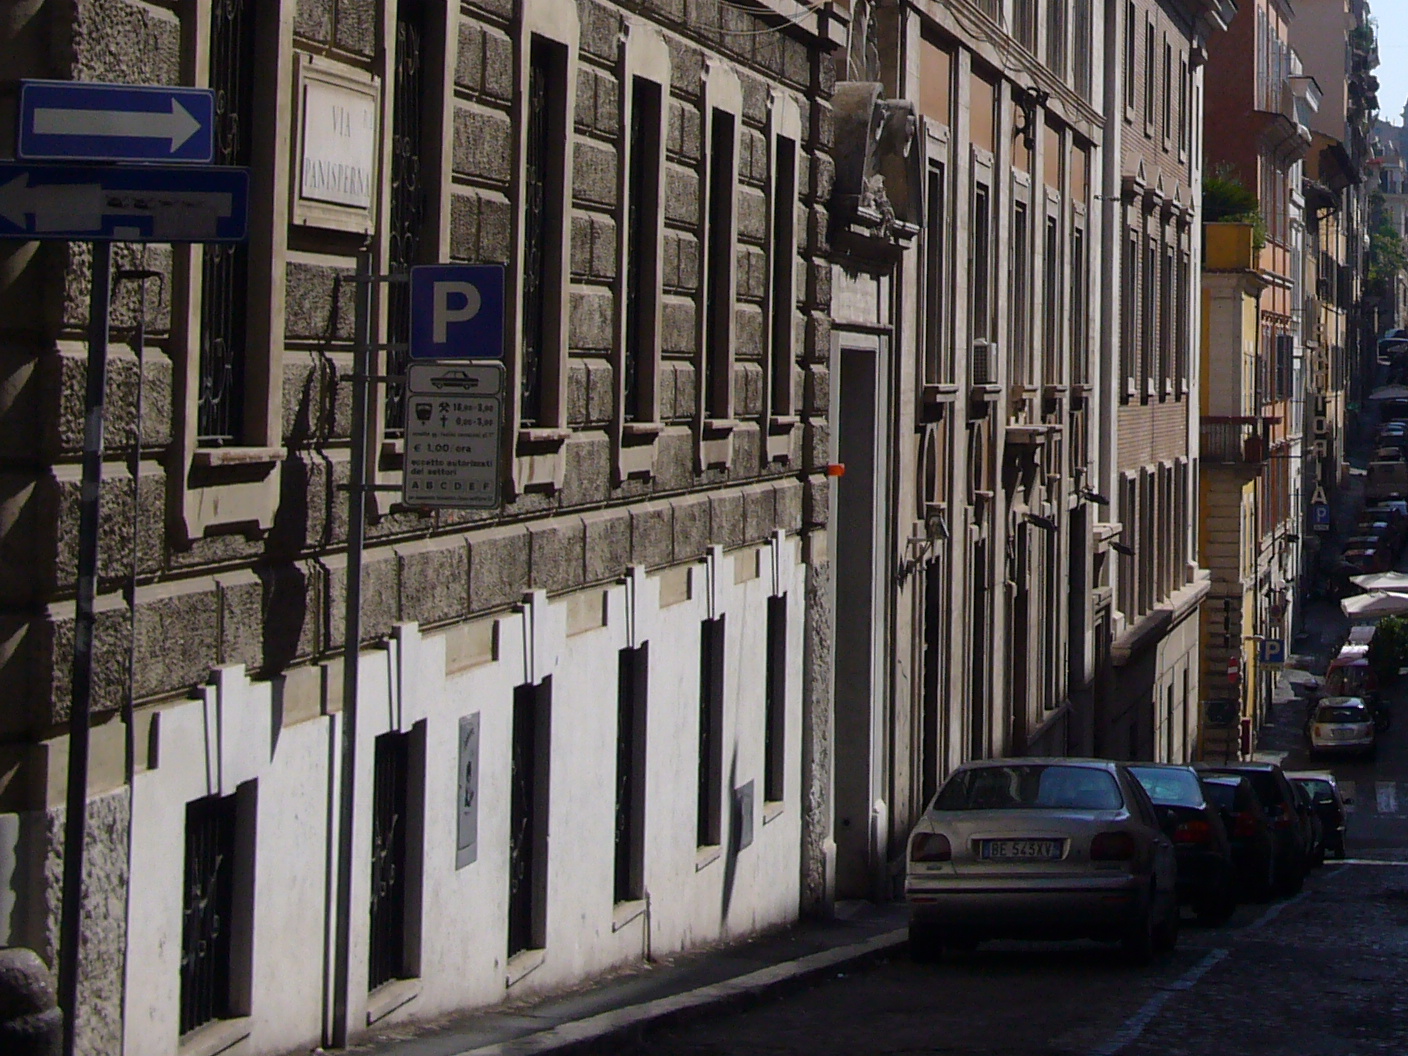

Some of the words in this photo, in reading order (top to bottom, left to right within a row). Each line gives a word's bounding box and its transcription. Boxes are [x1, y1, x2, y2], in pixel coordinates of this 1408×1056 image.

[332, 105, 351, 138] VIA
[305, 157, 370, 198] PANISPERNA
[433, 281, 481, 343] P
[412, 481, 419, 489] A
[426, 481, 433, 489] B
[440, 482, 447, 490] C
[454, 482, 461, 490] D
[469, 482, 475, 490] E
[483, 482, 490, 490] F
[1316, 507, 1327, 522] P
[1265, 641, 1280, 661] P
